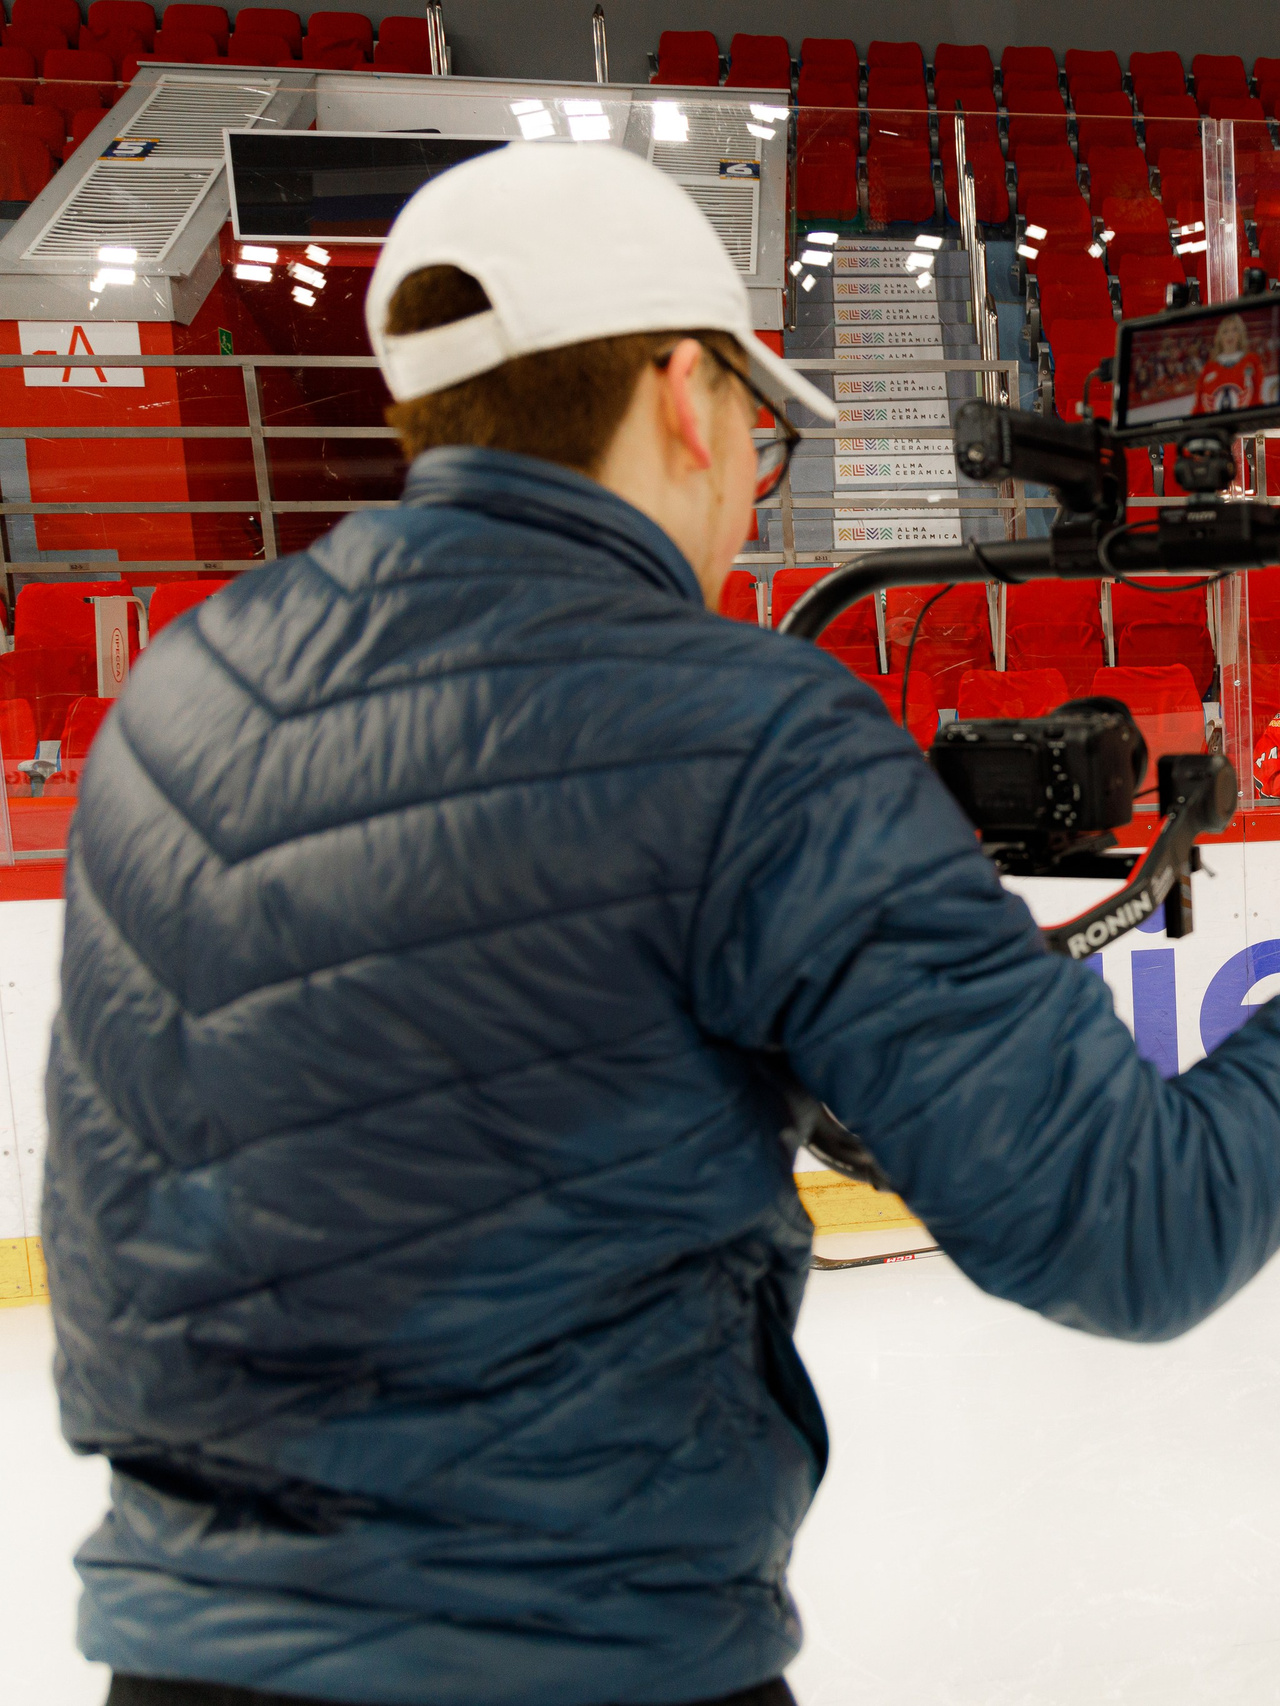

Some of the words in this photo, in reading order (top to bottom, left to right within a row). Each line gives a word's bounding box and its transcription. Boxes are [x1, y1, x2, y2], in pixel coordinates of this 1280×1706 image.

[113, 142, 147, 155] 5
[726, 163, 753, 175] 6
[114, 633, 122, 678] ПРЕССА
[1066, 889, 1154, 960] RONIN
